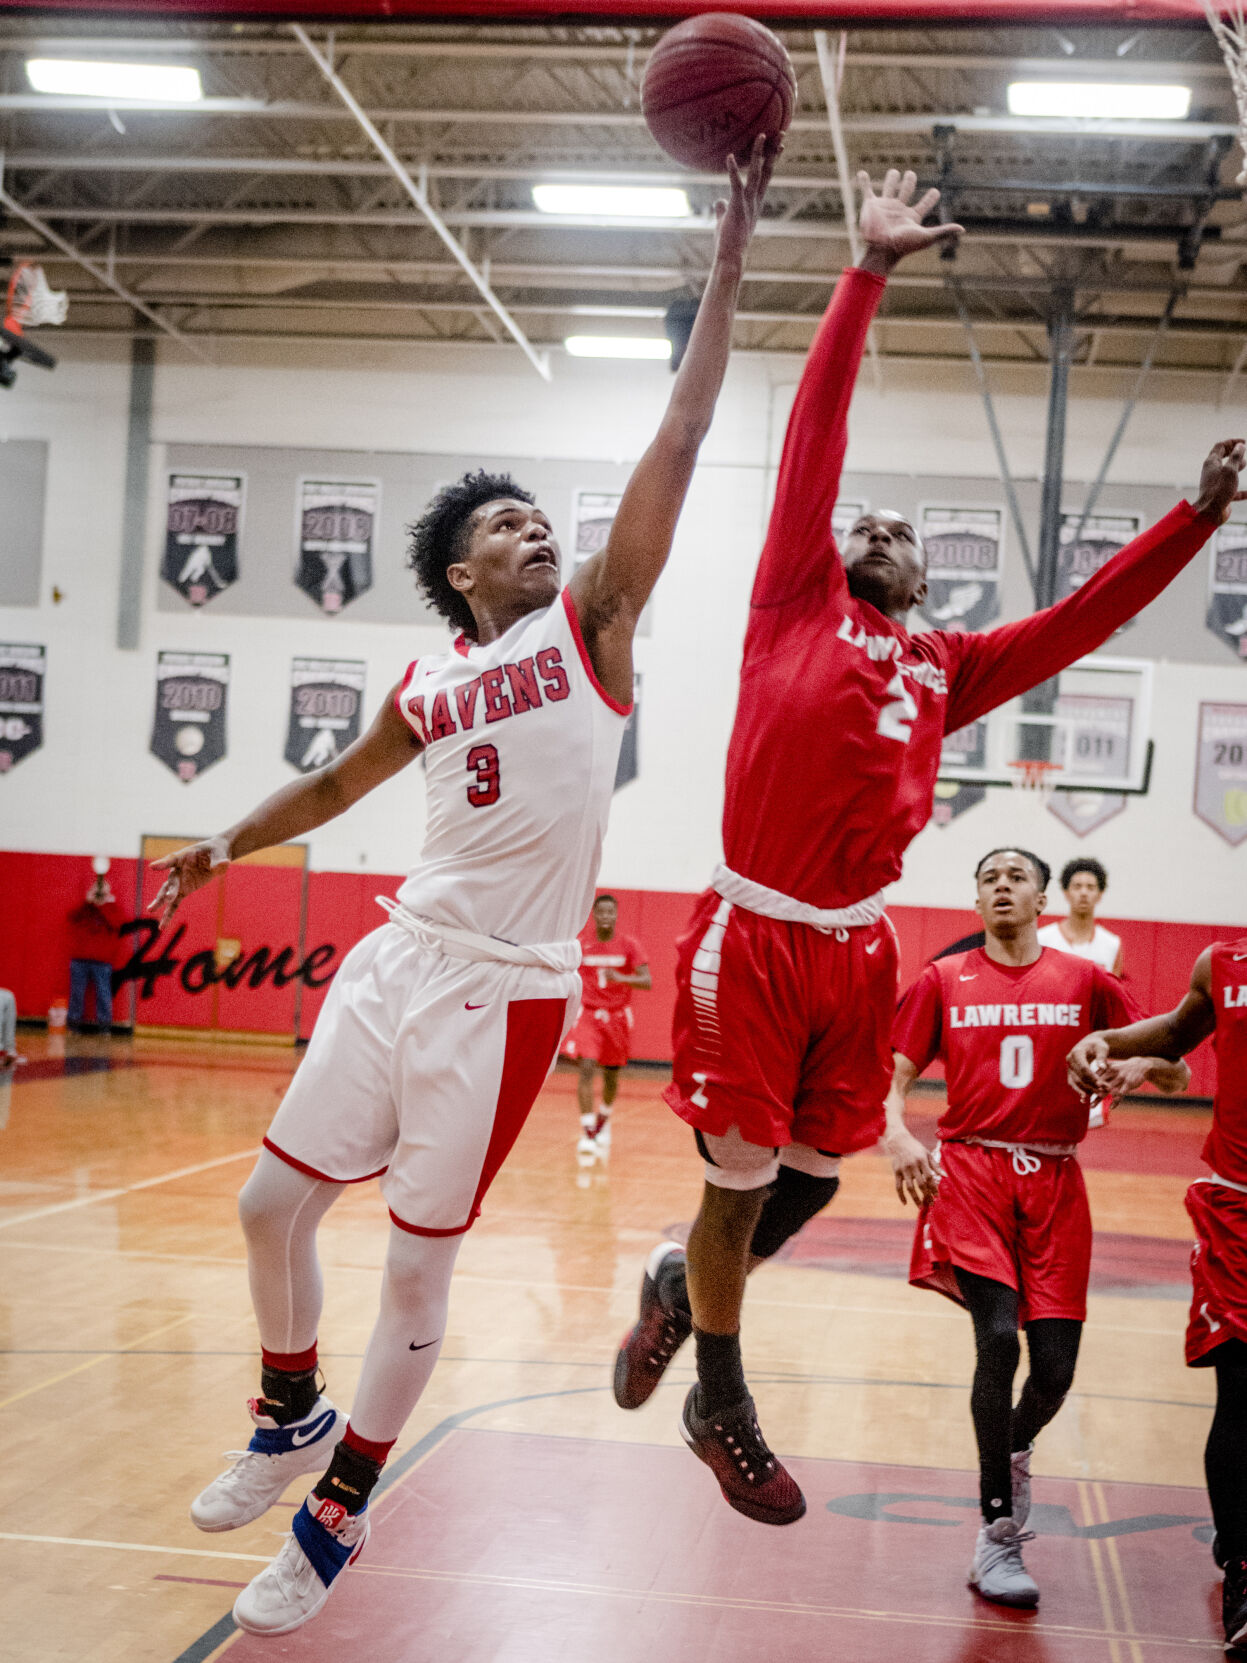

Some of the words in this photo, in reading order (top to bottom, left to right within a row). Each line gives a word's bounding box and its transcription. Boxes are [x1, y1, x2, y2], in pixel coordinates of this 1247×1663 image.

[875, 673, 919, 745] 2
[466, 742, 501, 809] 3
[111, 917, 337, 1000] Home
[949, 1003, 1083, 1028] LAWRENCE
[1000, 1034, 1034, 1089] 0
